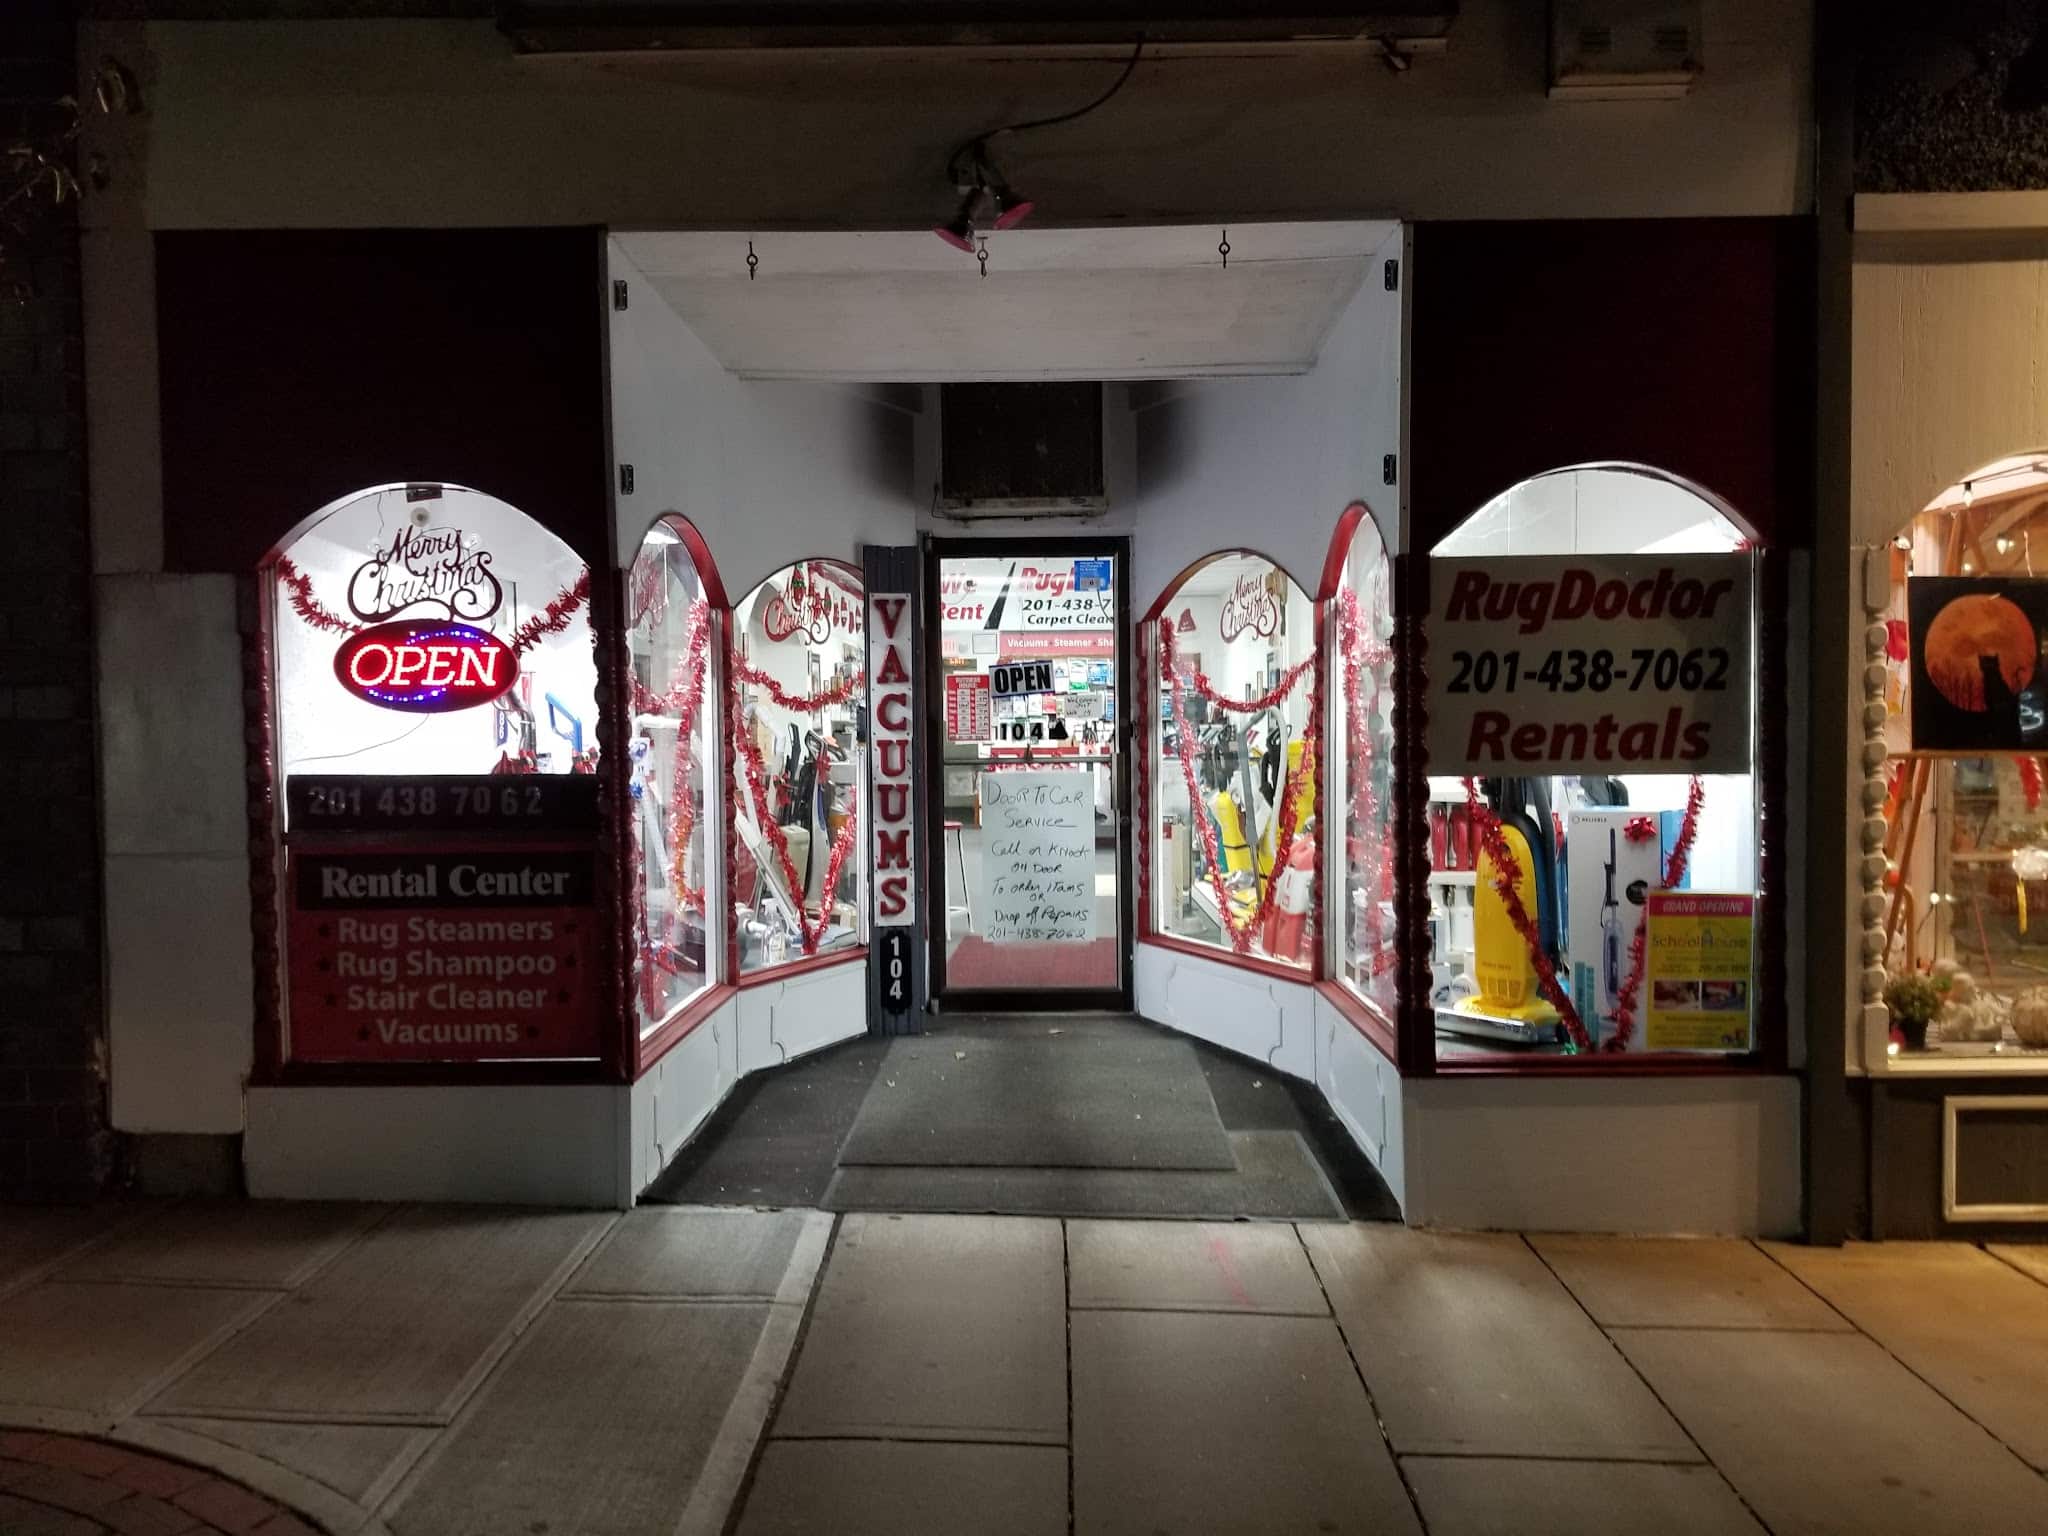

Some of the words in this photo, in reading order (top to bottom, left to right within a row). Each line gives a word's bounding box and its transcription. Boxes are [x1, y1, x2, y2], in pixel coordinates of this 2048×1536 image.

[376, 525, 463, 572] Merry
[348, 550, 503, 622] Christmas
[1230, 574, 1263, 604] Merry
[1444, 568, 1734, 634] RugDoctor
[1022, 599, 1114, 612] 201-438-7
[1027, 614, 1073, 628] Carpet
[1220, 587, 1278, 644] Christmas
[1007, 639, 1048, 648] Vacuums
[349, 642, 502, 688] OPEN
[994, 664, 1051, 694] OPEN
[1446, 648, 1731, 694] 201-438-7062
[1466, 706, 1712, 762] Rentals
[874, 599, 910, 917] VACUUMS
[309, 786, 363, 817] 201
[377, 786, 438, 817] 438
[321, 864, 437, 899] Rental
[449, 864, 571, 897] Center
[1662, 900, 1697, 913] GRAND
[1699, 900, 1745, 913] OPENING
[338, 917, 399, 949] Rug
[407, 917, 554, 943] Steamers
[337, 951, 399, 983] Rug
[407, 951, 557, 984] Shampoo
[889, 935, 903, 1000] 104
[347, 984, 419, 1011] Stair
[427, 983, 548, 1010] Cleaner
[376, 1018, 520, 1045] Vacuums
